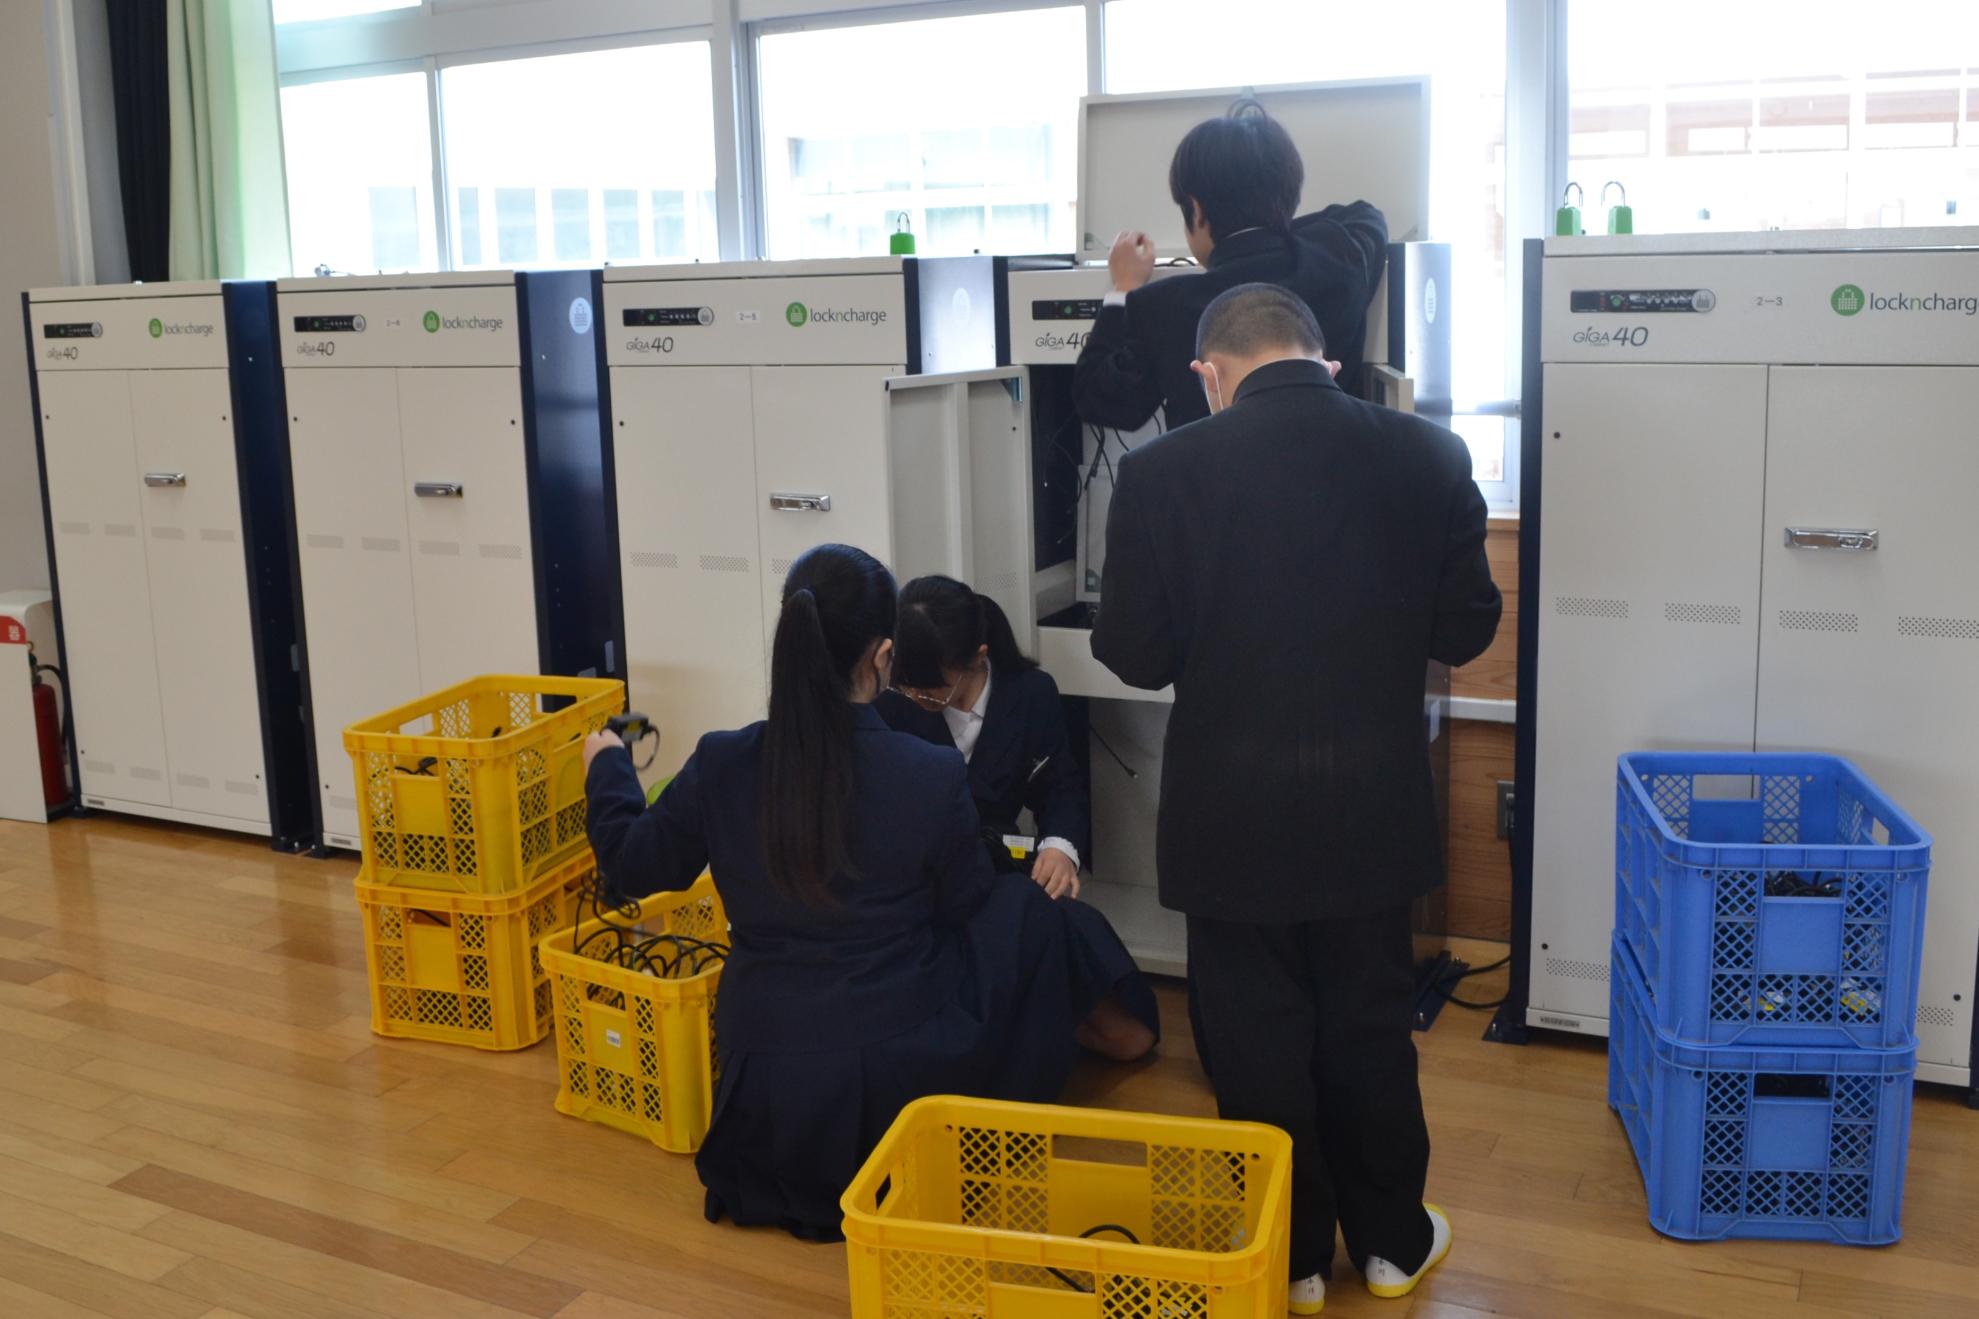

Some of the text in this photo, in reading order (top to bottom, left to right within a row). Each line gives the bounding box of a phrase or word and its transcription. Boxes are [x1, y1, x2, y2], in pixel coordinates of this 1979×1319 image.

[1870, 292, 1979, 316] lockncharg
[810, 307, 887, 325] lockncharge
[651, 336, 674, 353] 40
[1612, 326, 1649, 346] 40
[316, 341, 335, 356] 40
